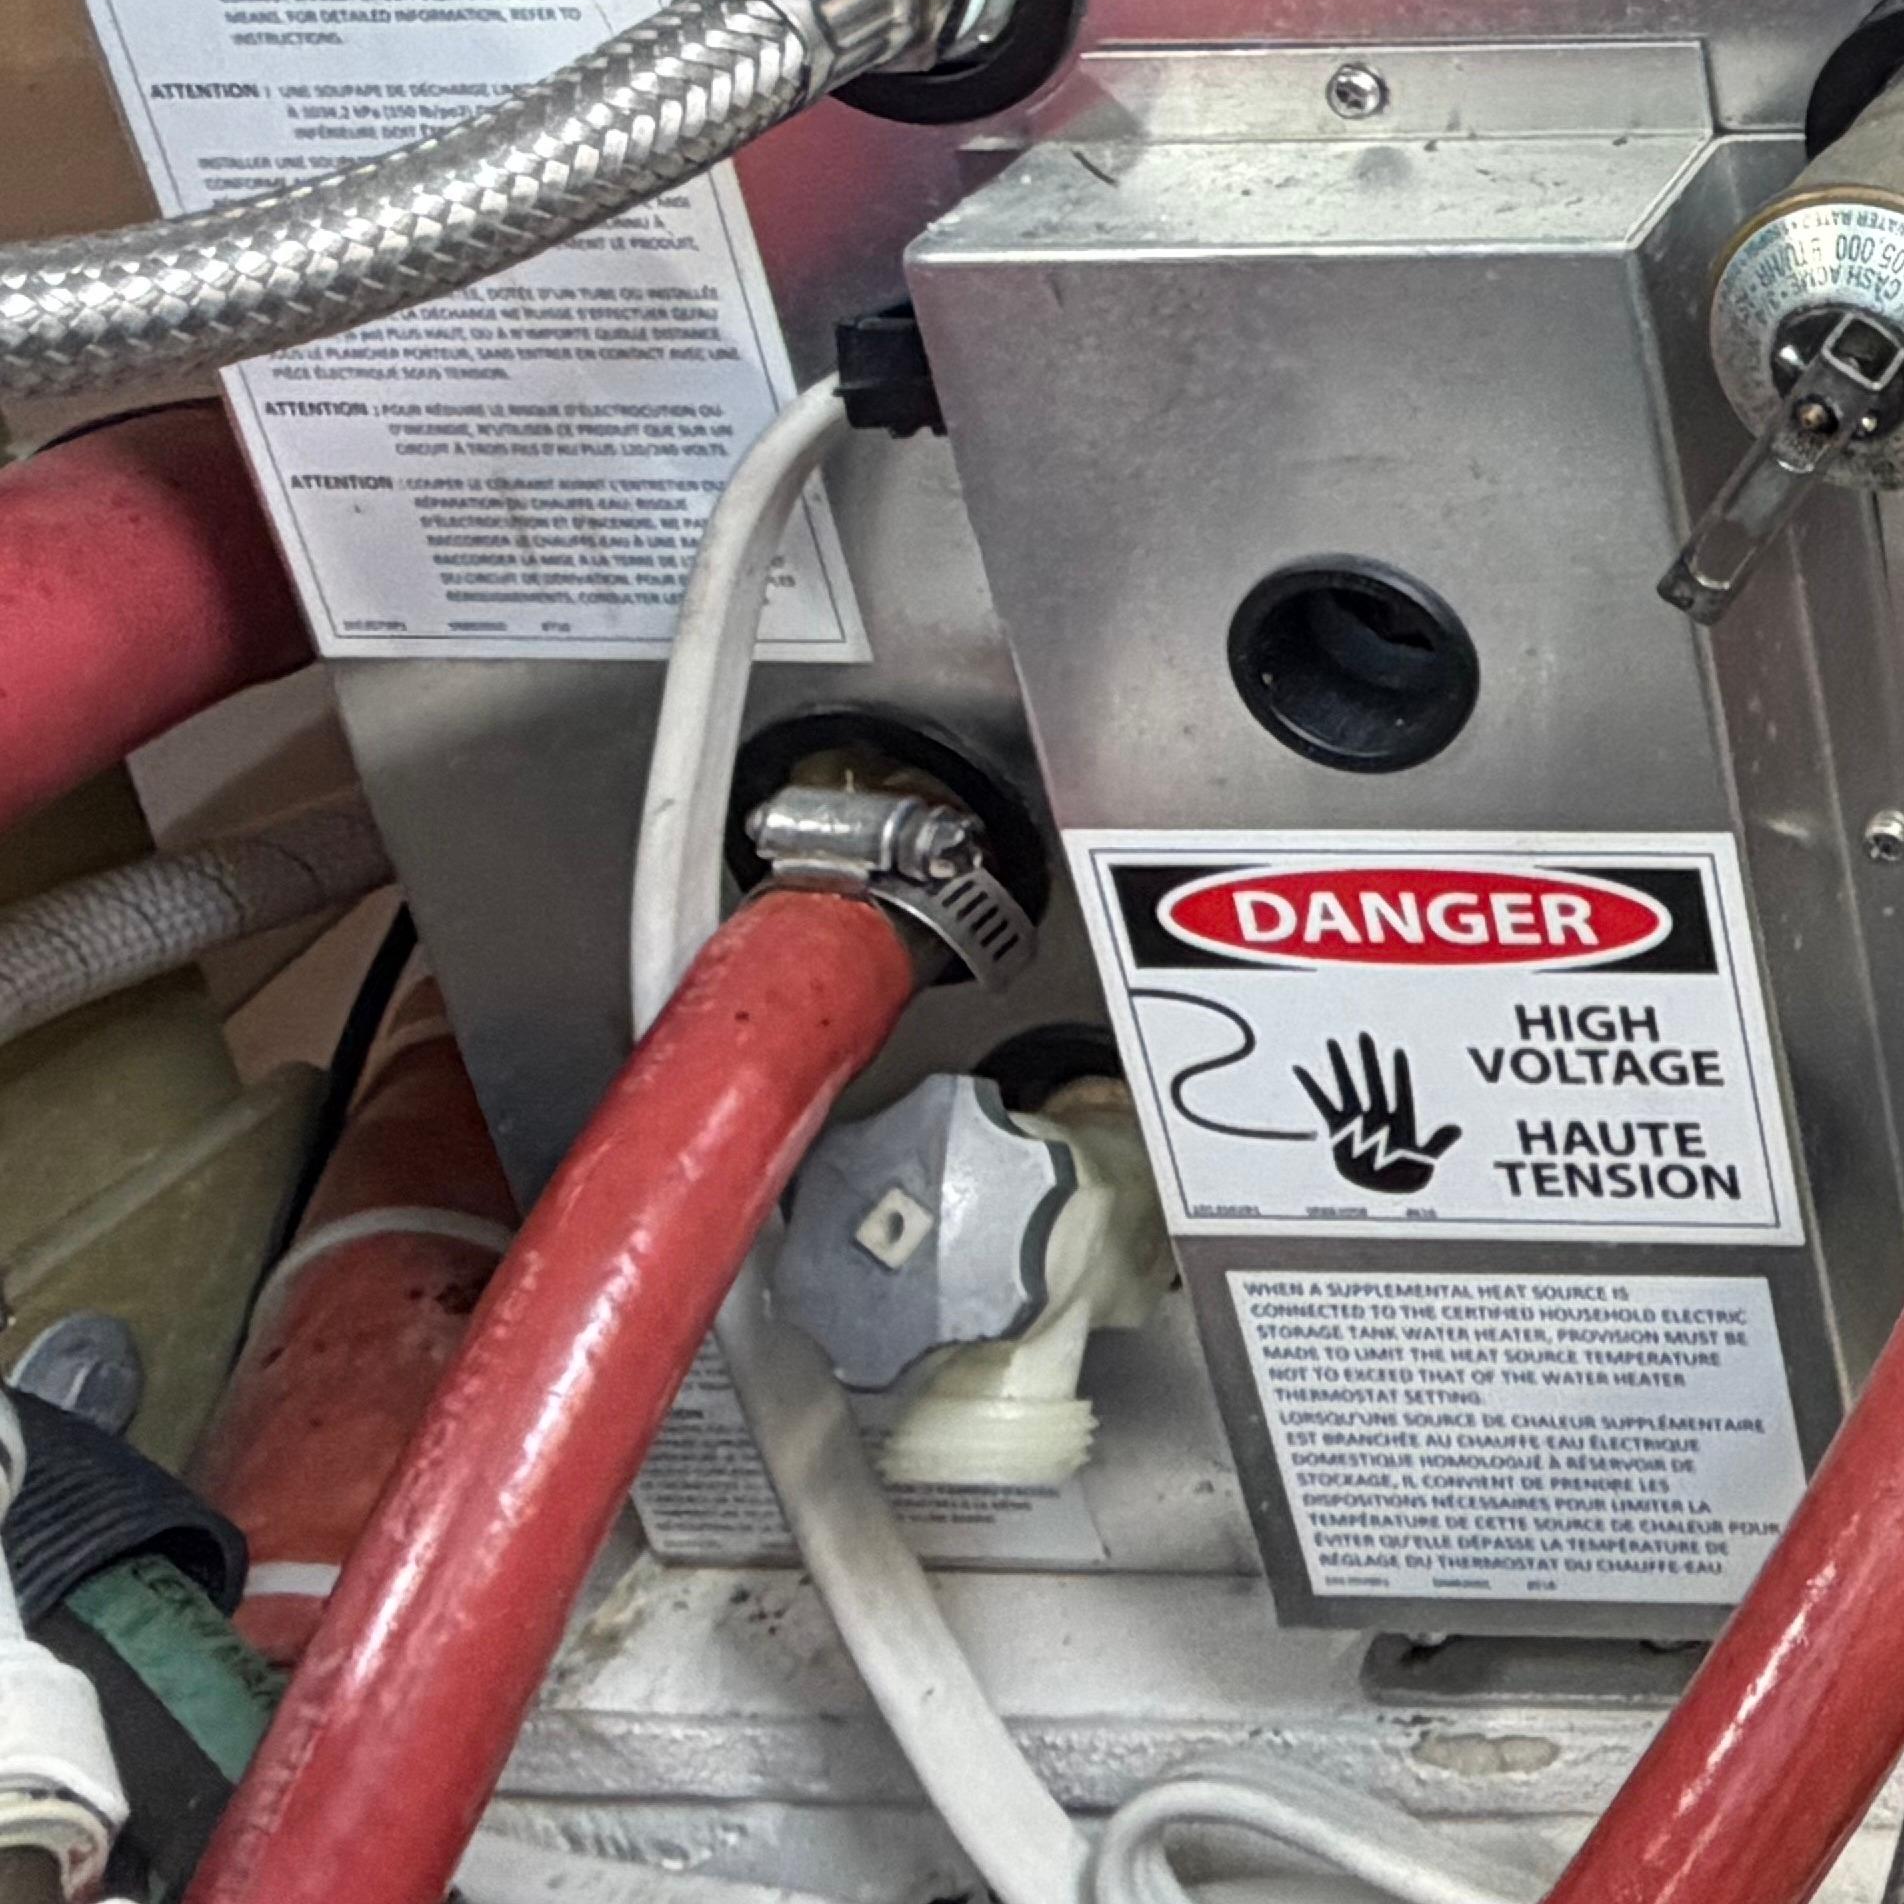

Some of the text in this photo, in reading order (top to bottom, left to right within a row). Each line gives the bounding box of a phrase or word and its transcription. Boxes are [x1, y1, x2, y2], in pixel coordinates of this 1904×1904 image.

[150, 83, 260, 100] ATTENTION
[264, 400, 369, 417] ATTENTION
[291, 474, 394, 490] ATTENTION
[1233, 890, 1597, 949] DANGER
[1515, 1004, 1660, 1043] HIGH
[1469, 1047, 1724, 1087] VOLTAGE
[1517, 1119, 1705, 1158] HAUTE
[1494, 1161, 1741, 1200] TENSION
